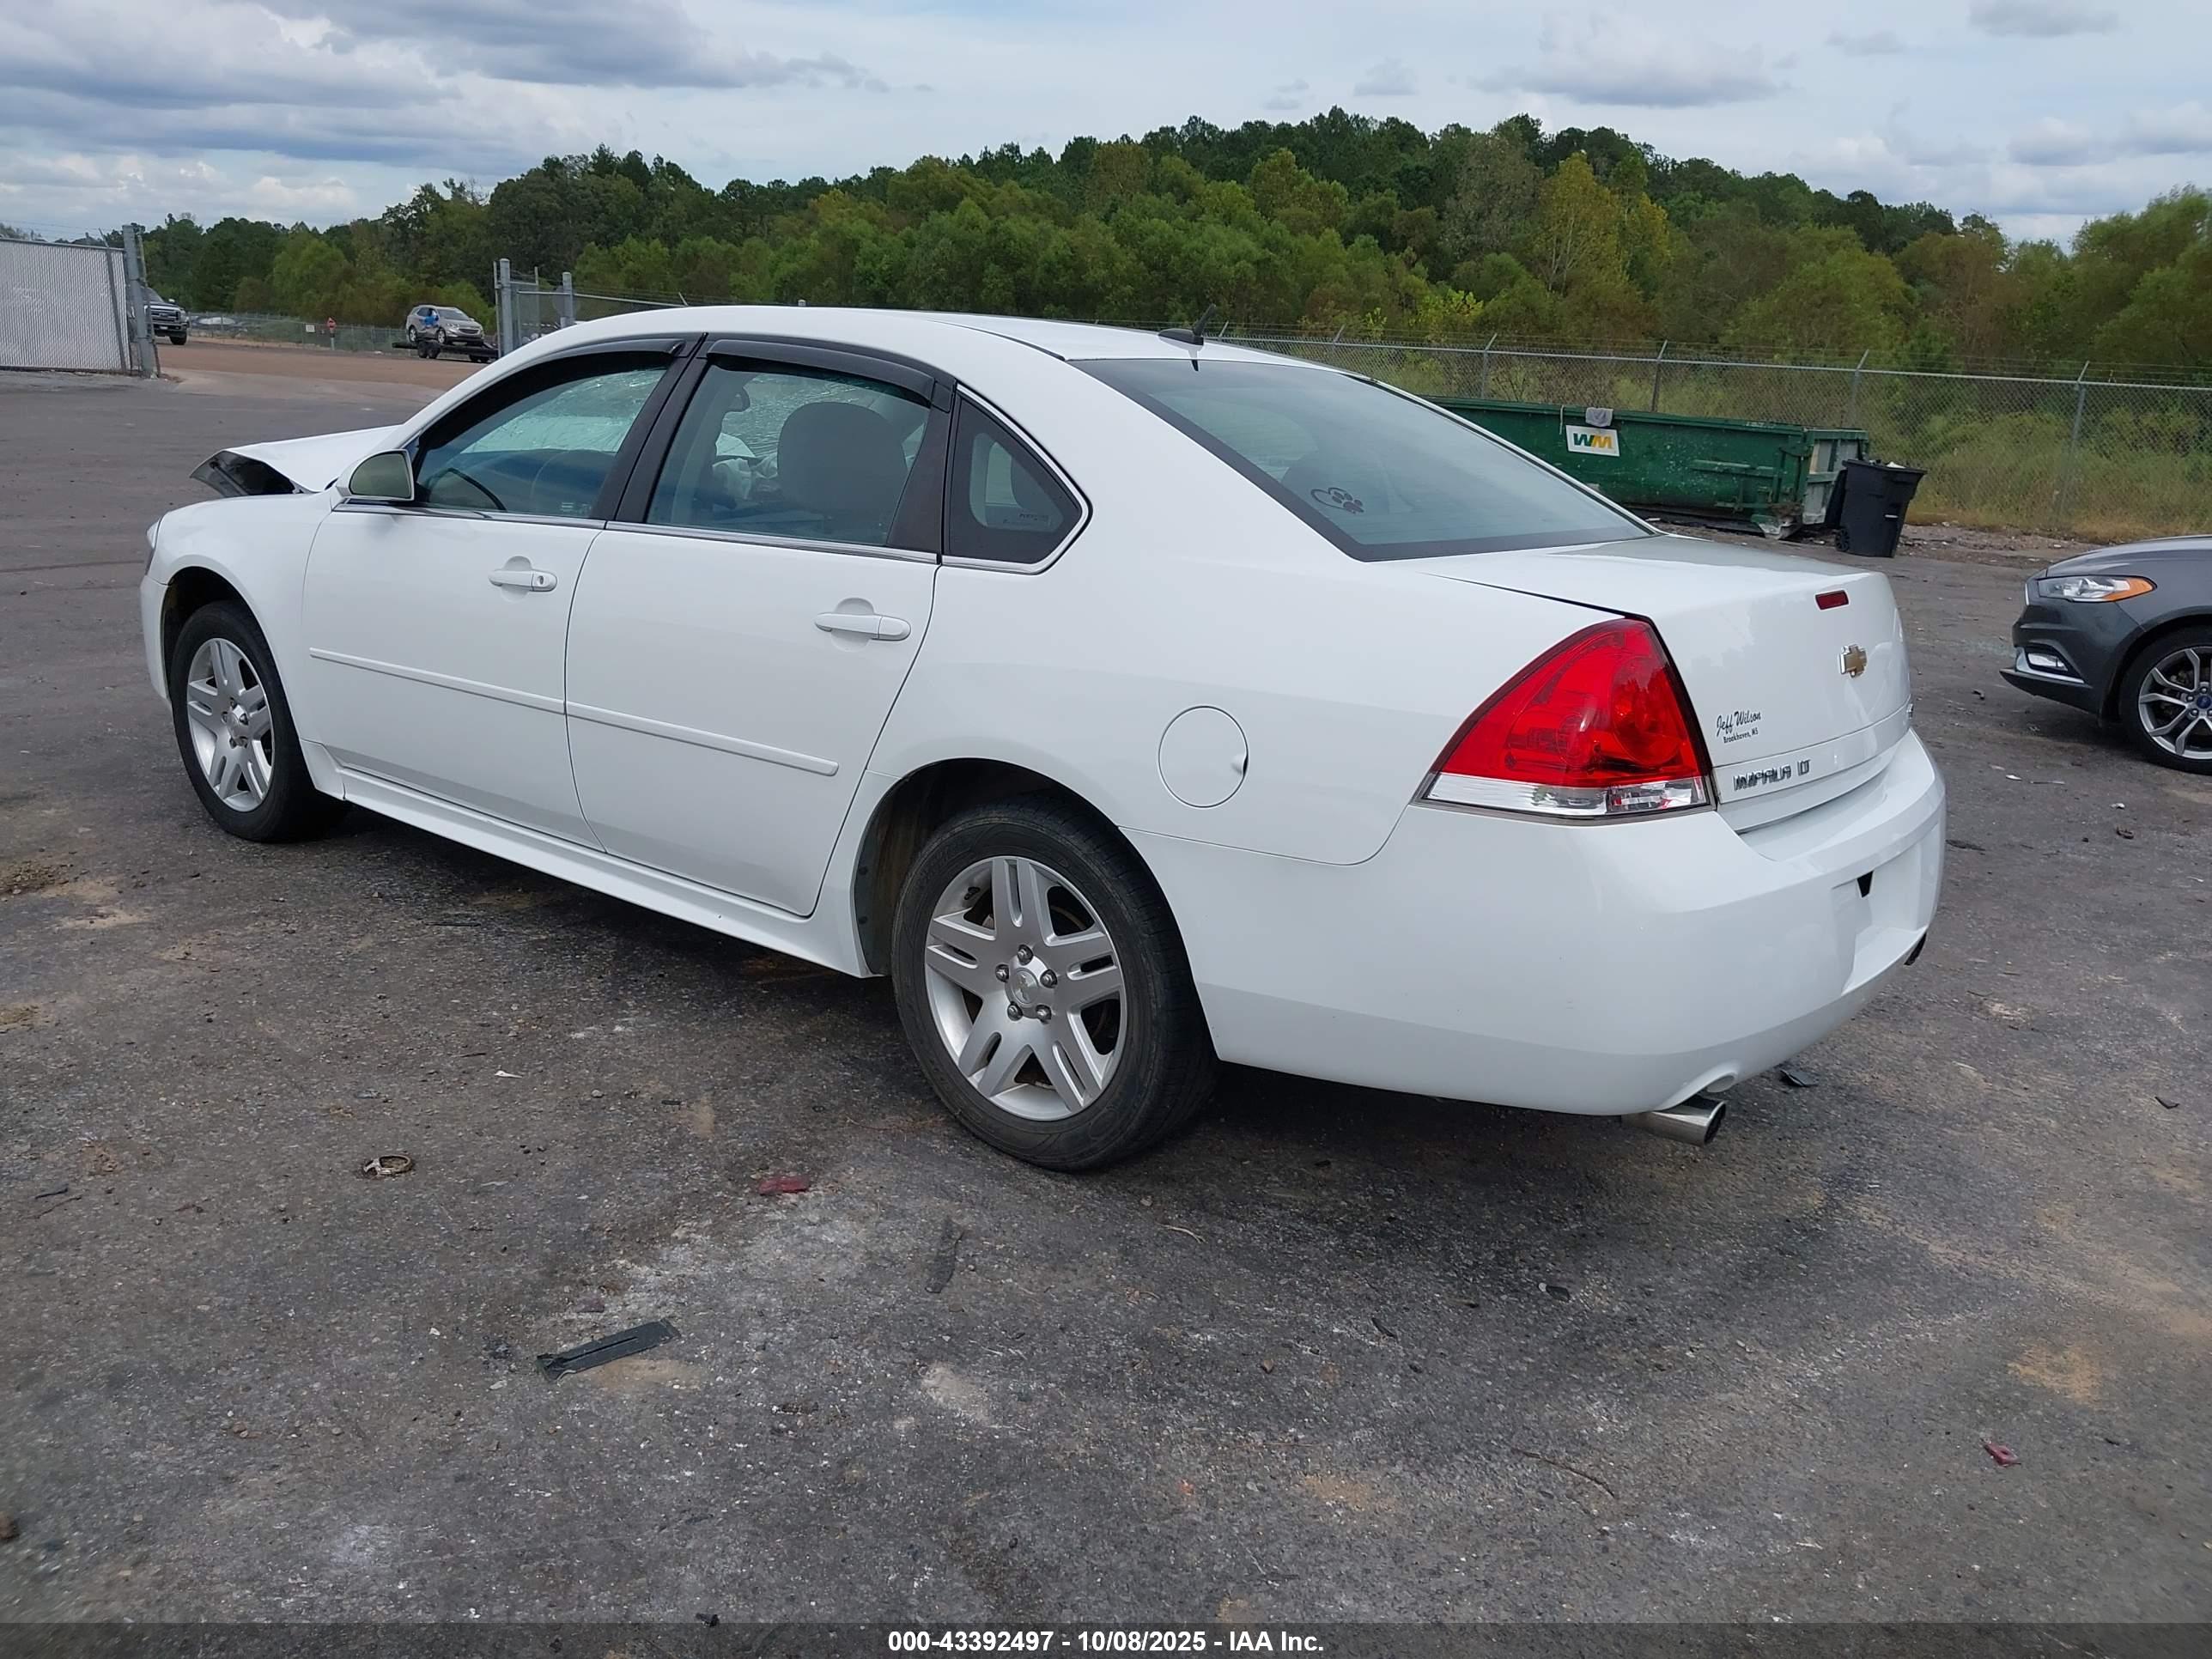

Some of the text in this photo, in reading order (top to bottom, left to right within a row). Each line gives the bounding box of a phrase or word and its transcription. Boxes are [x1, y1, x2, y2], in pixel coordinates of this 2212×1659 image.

[1573, 433, 1613, 449] WM
[1717, 710, 1761, 737] Jeff Wilson
[1752, 727, 1759, 736] MS
[1733, 765, 1792, 791] IMPALA
